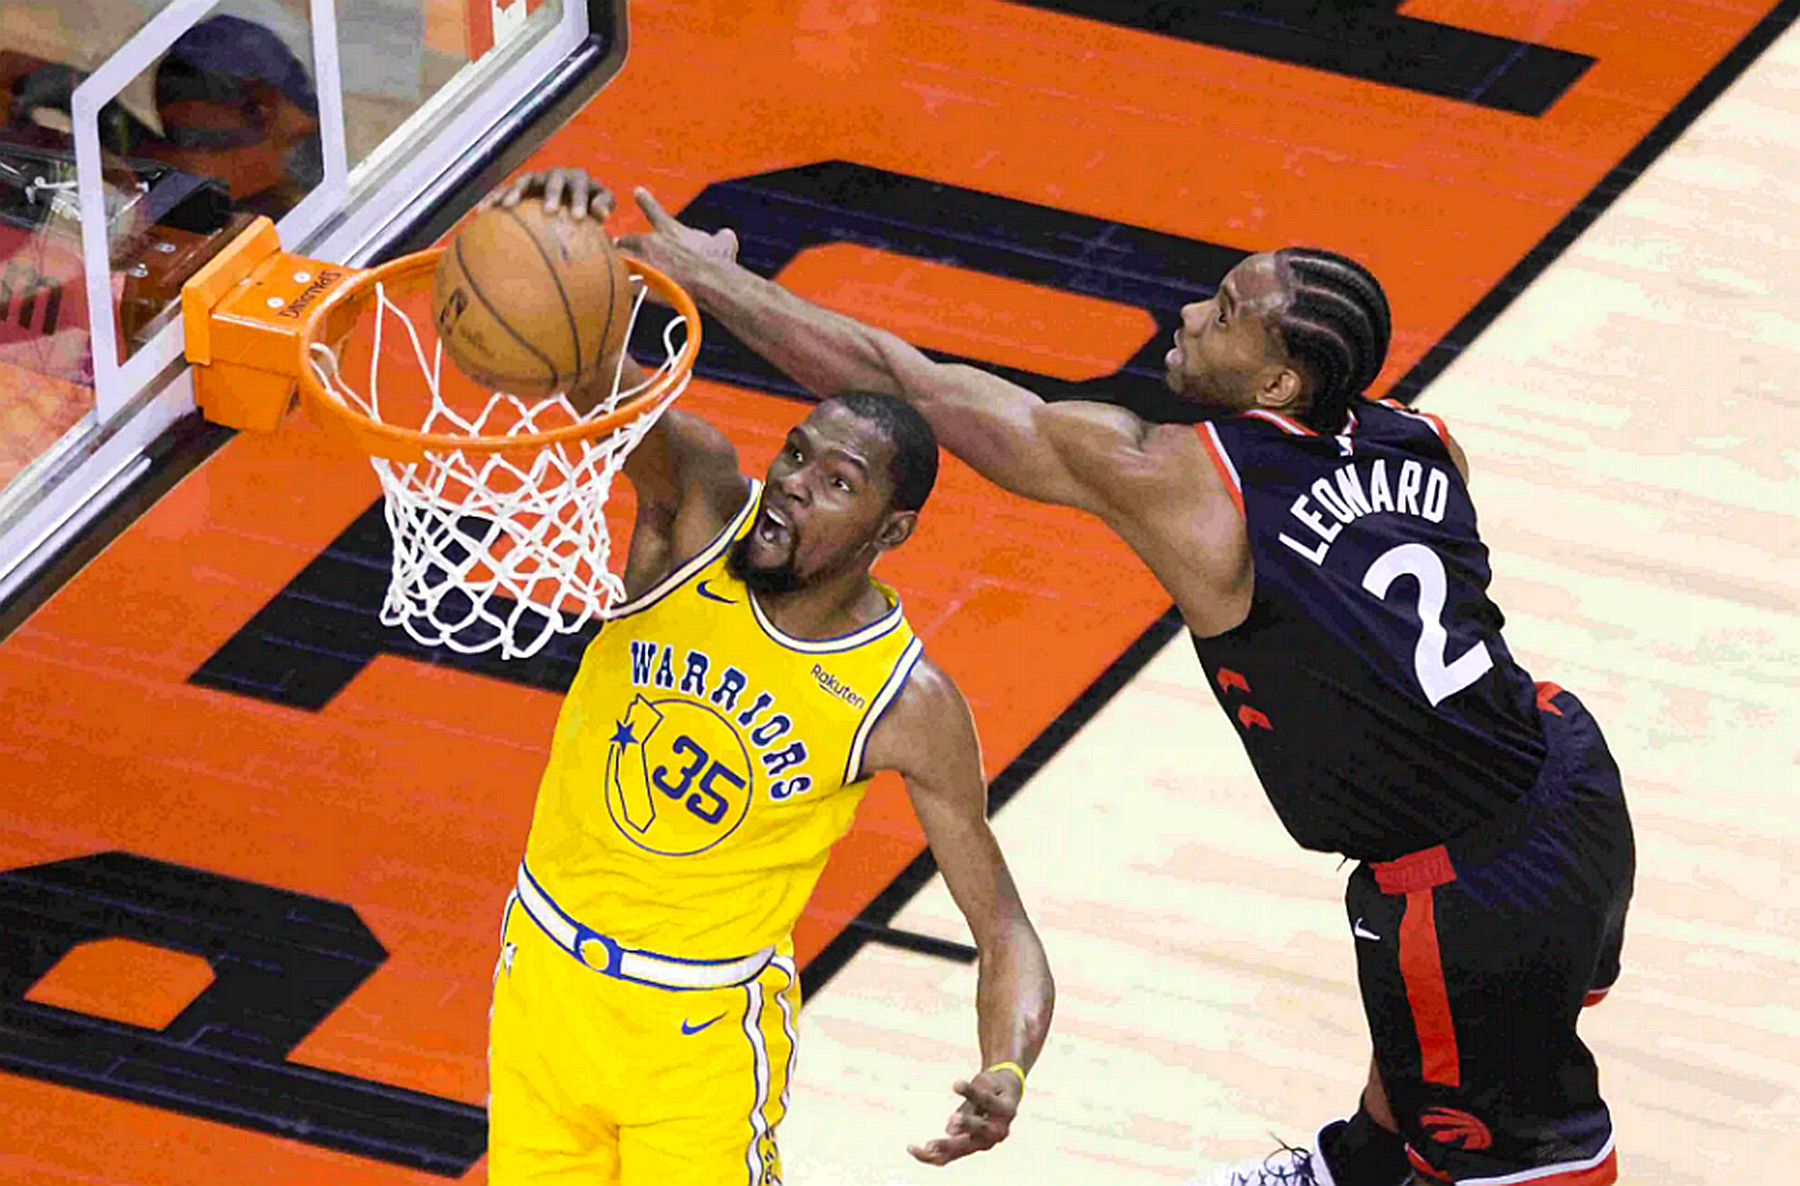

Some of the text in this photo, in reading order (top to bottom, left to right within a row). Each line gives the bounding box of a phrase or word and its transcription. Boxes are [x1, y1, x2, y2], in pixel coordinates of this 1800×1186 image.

[1278, 458, 1449, 567] LEONARD
[1362, 543, 1494, 708] 2
[630, 640, 812, 800] WARRIORS
[810, 663, 866, 710] Rakuten
[652, 735, 747, 825] 35
